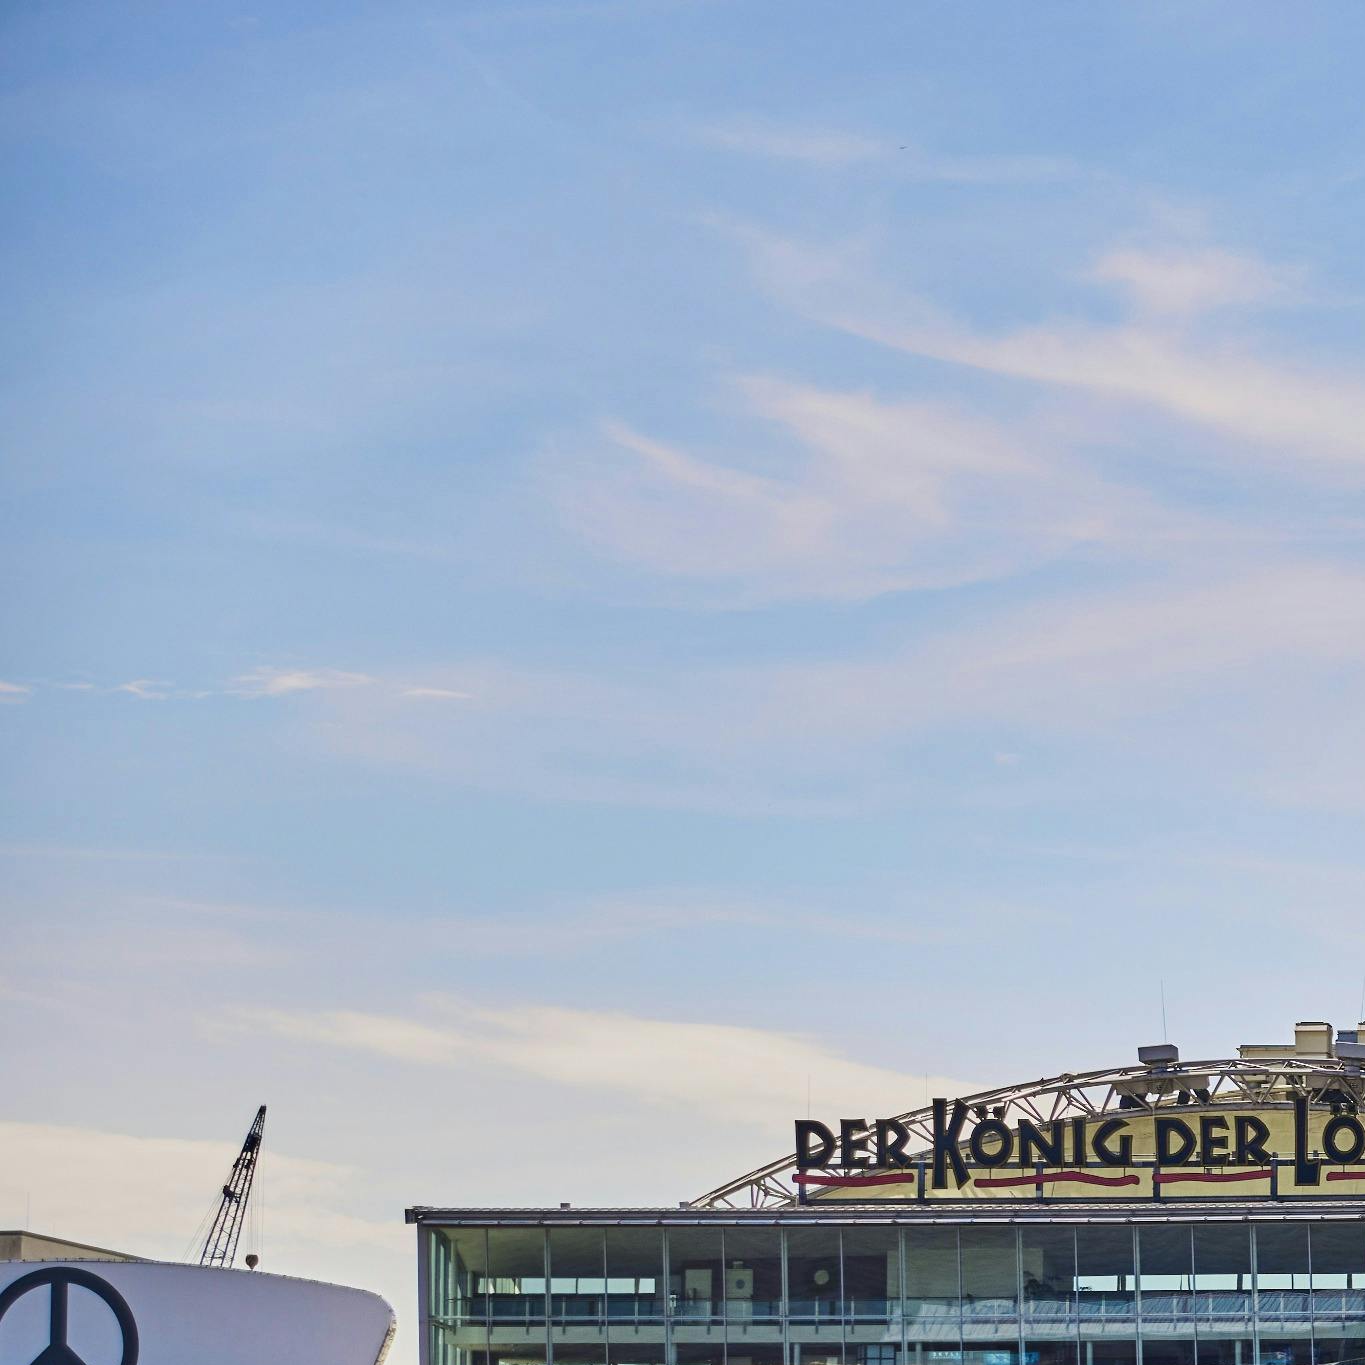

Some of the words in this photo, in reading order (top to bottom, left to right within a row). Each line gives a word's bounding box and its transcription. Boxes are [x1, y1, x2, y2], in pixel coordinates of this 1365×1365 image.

[794, 1118, 914, 1171] DER
[931, 1097, 1135, 1190] KÖNIG
[1154, 1115, 1273, 1167] DER
